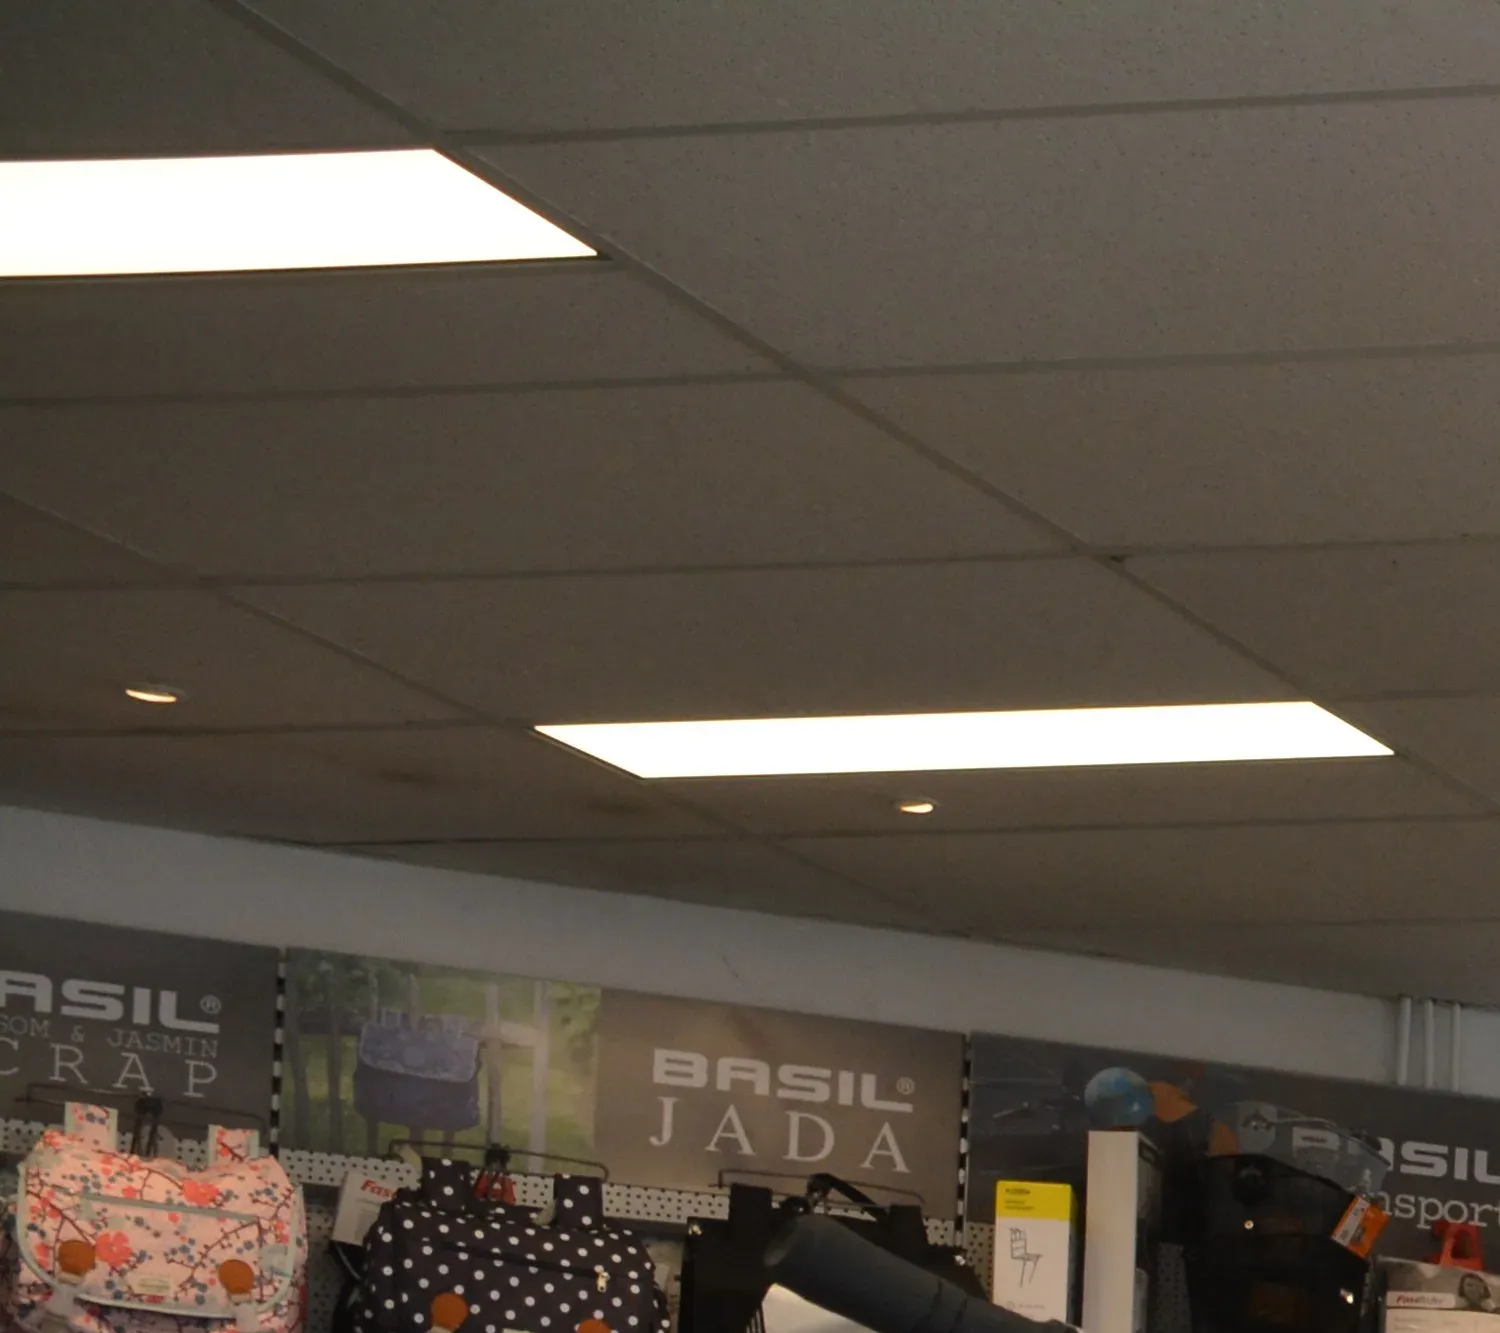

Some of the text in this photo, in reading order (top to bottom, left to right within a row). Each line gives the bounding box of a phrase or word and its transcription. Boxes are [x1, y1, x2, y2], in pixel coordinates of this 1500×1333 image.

[0, 969, 220, 1034] ASIL
[0, 1036, 218, 1098] CRAP
[106, 1028, 219, 1059] JASMIN
[649, 1095, 912, 1174] JADA
